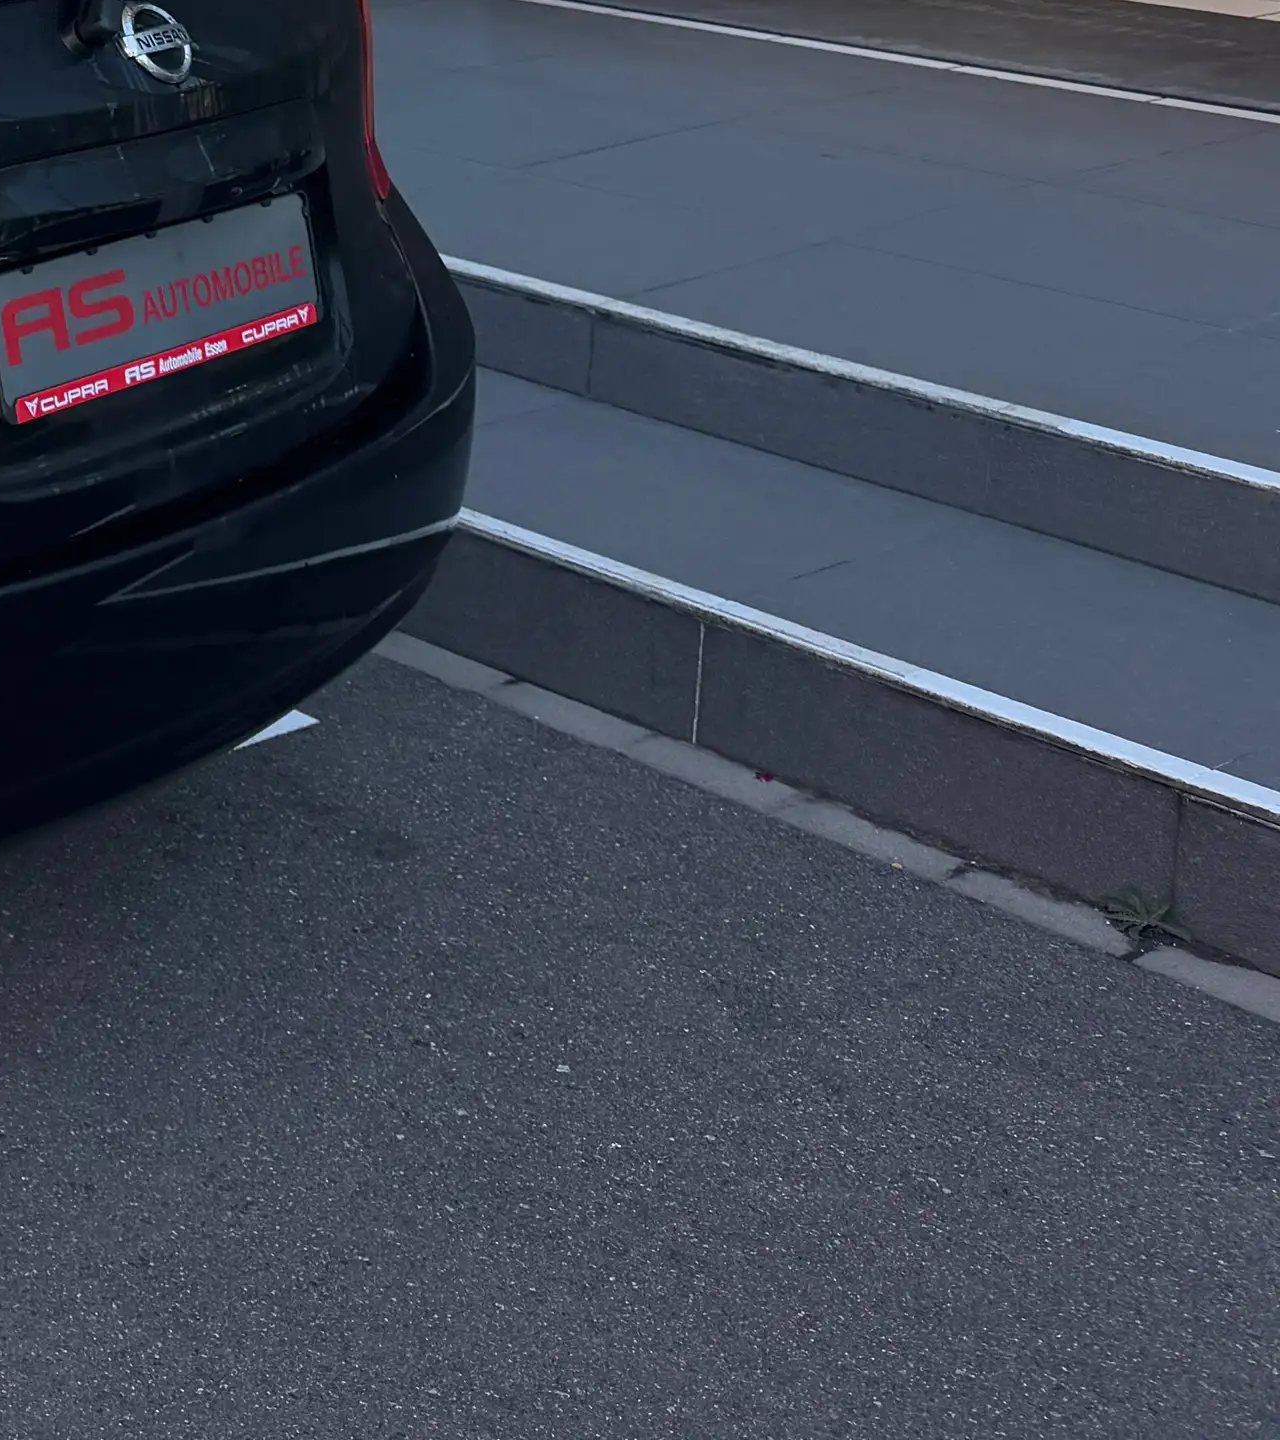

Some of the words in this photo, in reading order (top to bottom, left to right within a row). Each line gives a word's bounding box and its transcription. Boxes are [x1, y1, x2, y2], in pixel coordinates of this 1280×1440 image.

[136, 28, 188, 50] NISSAN
[0, 269, 135, 368] AS
[142, 245, 307, 325] AUTOMOBILE
[40, 379, 109, 412] CUPRA
[124, 359, 157, 385] AS
[159, 346, 203, 374] Automobile
[204, 338, 228, 358] Essen
[241, 314, 299, 343] CUPRA
